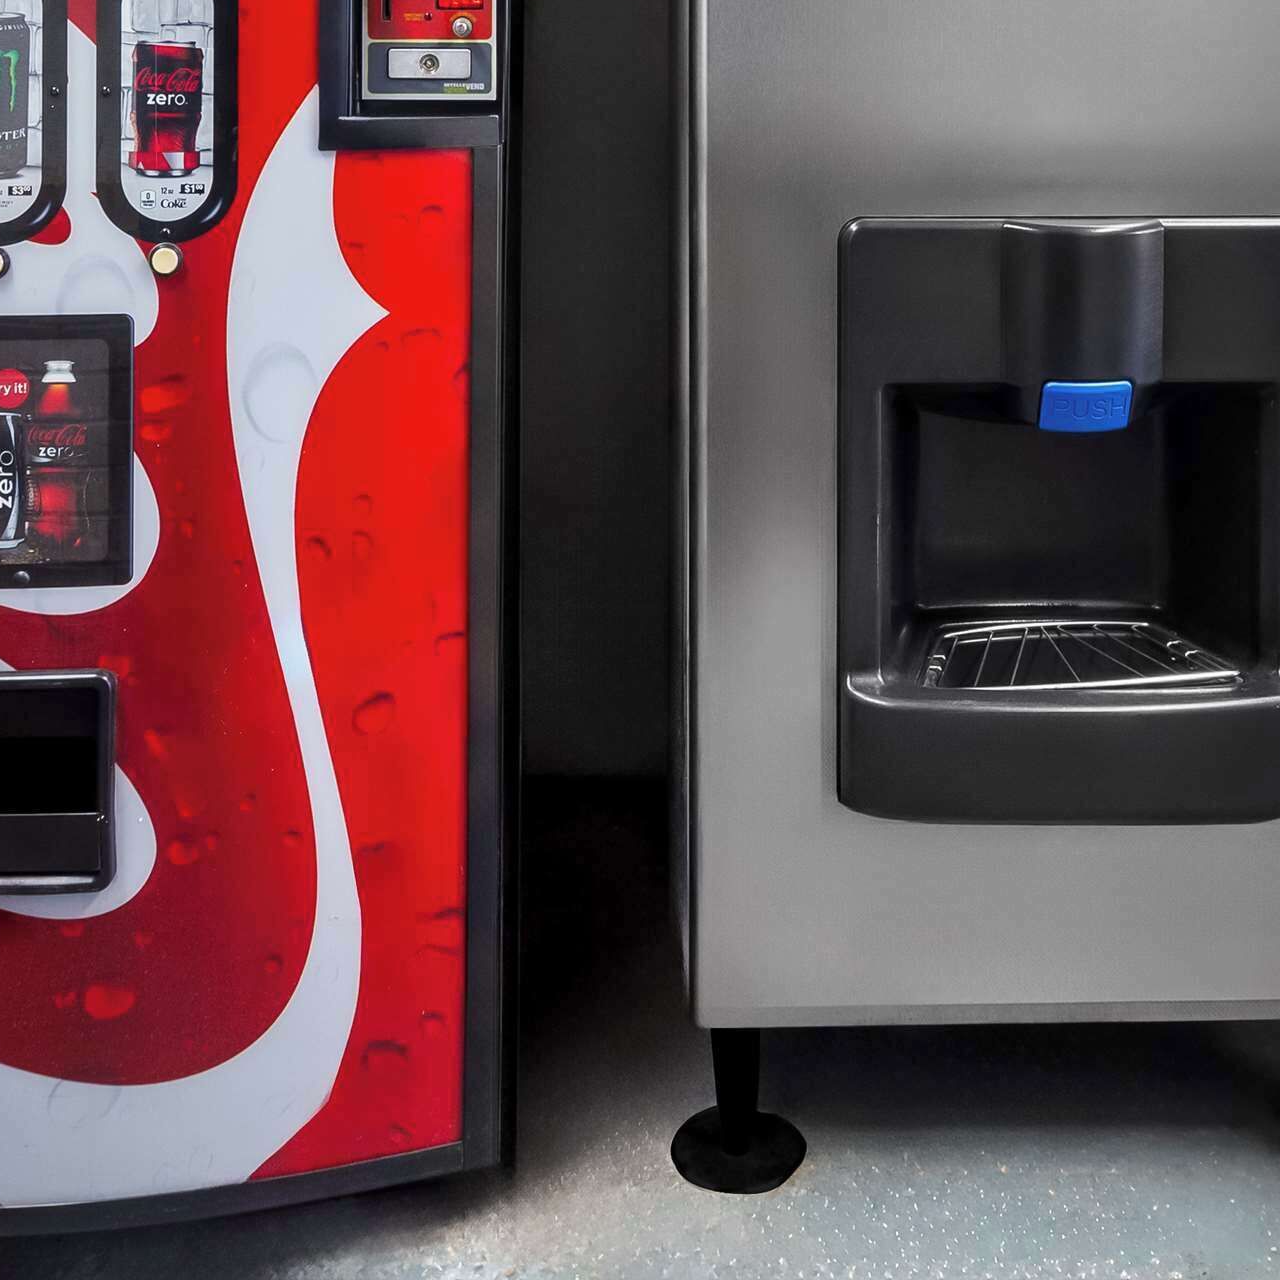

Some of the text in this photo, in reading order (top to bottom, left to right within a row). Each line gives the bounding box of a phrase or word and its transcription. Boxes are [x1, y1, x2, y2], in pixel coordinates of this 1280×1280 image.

[146, 93, 186, 106] zero
[14, 382, 28, 394] it!
[1048, 397, 1128, 420] PUSH
[38, 445, 74, 457] zero
